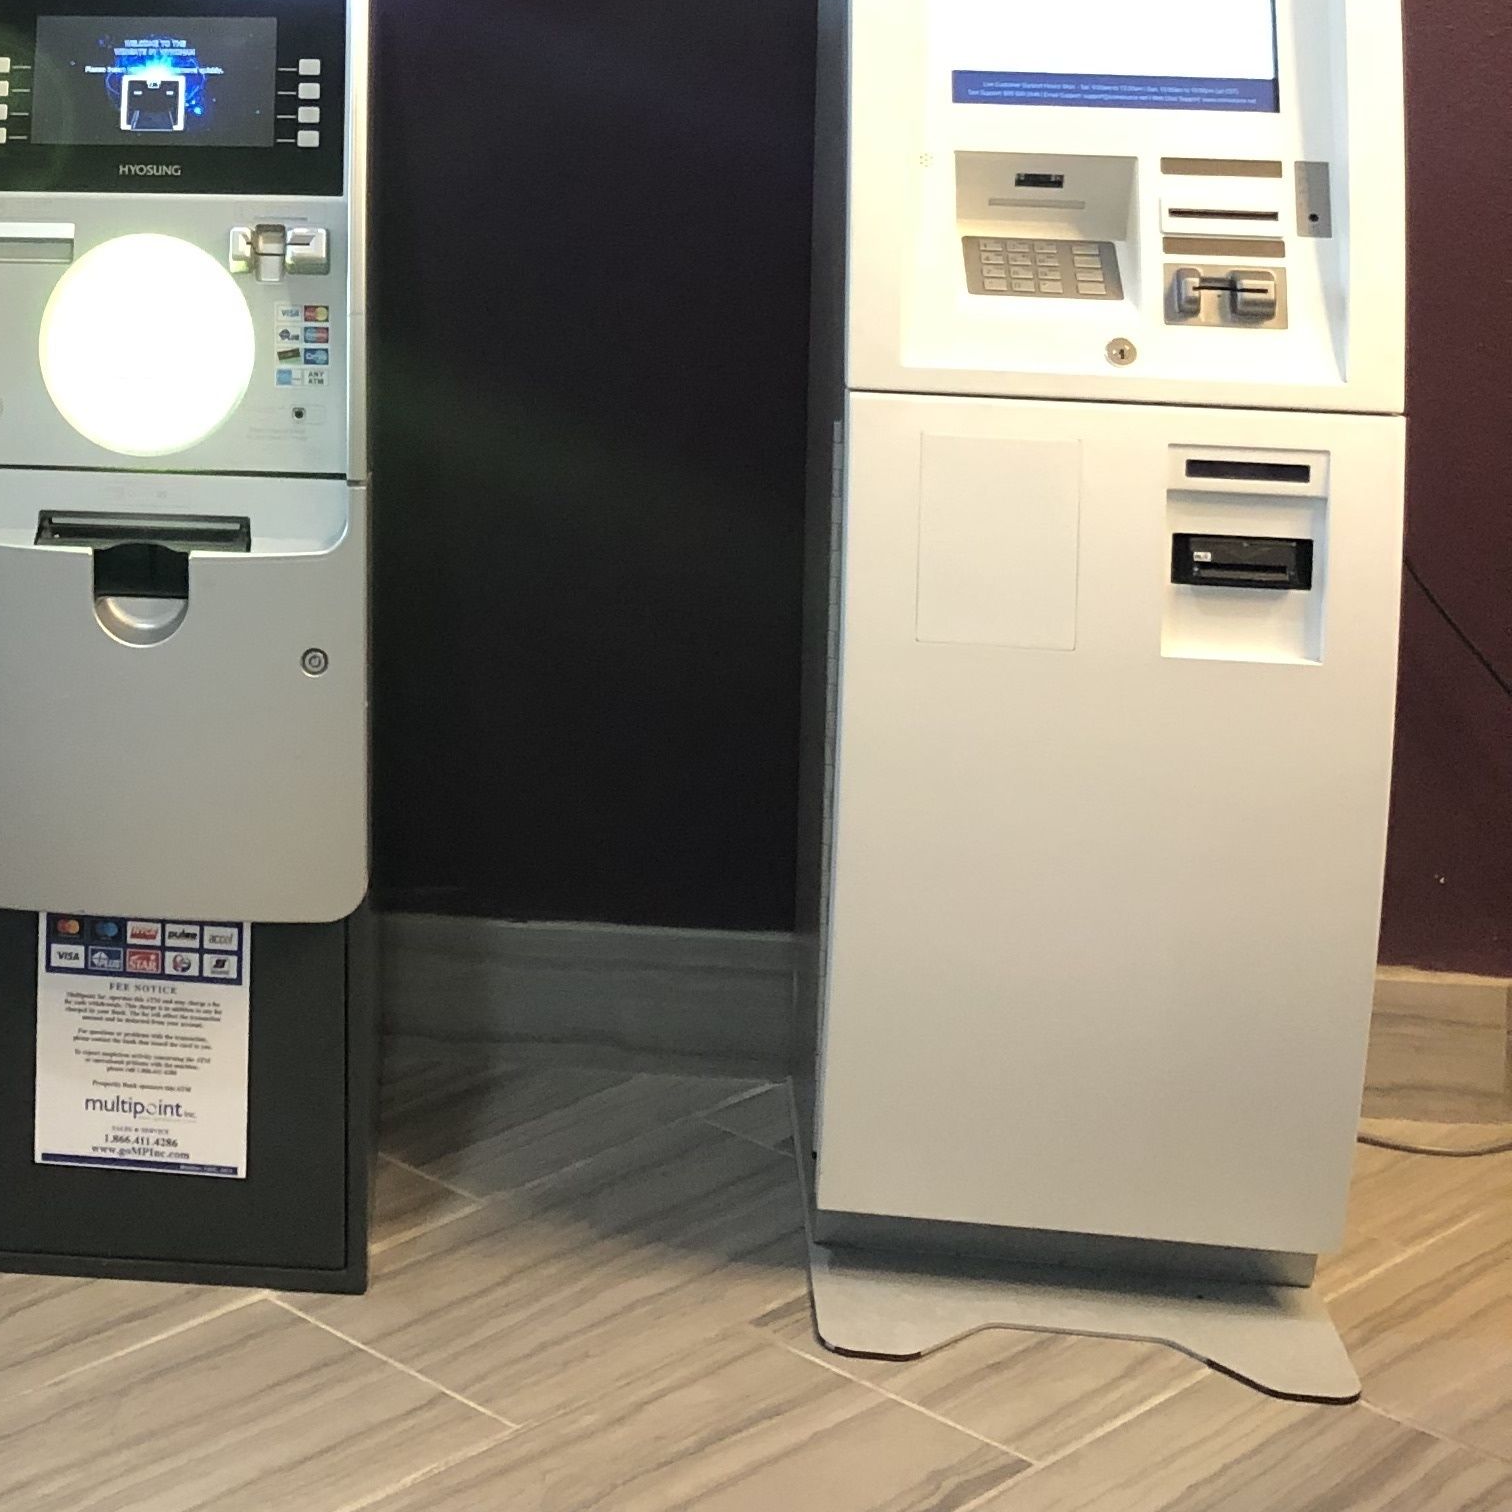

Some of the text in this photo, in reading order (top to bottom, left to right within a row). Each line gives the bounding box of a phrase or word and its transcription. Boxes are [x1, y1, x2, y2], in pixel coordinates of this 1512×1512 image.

[119, 164, 182, 177] HYOSUNG
[56, 952, 80, 961] VISA
[99, 959, 121, 970] PLUS
[129, 959, 158, 972] STAR
[109, 982, 177, 995] FEE NOTICE
[84, 1095, 183, 1119] multipoint
[91, 1145, 190, 1160] www.goMPInc.com
